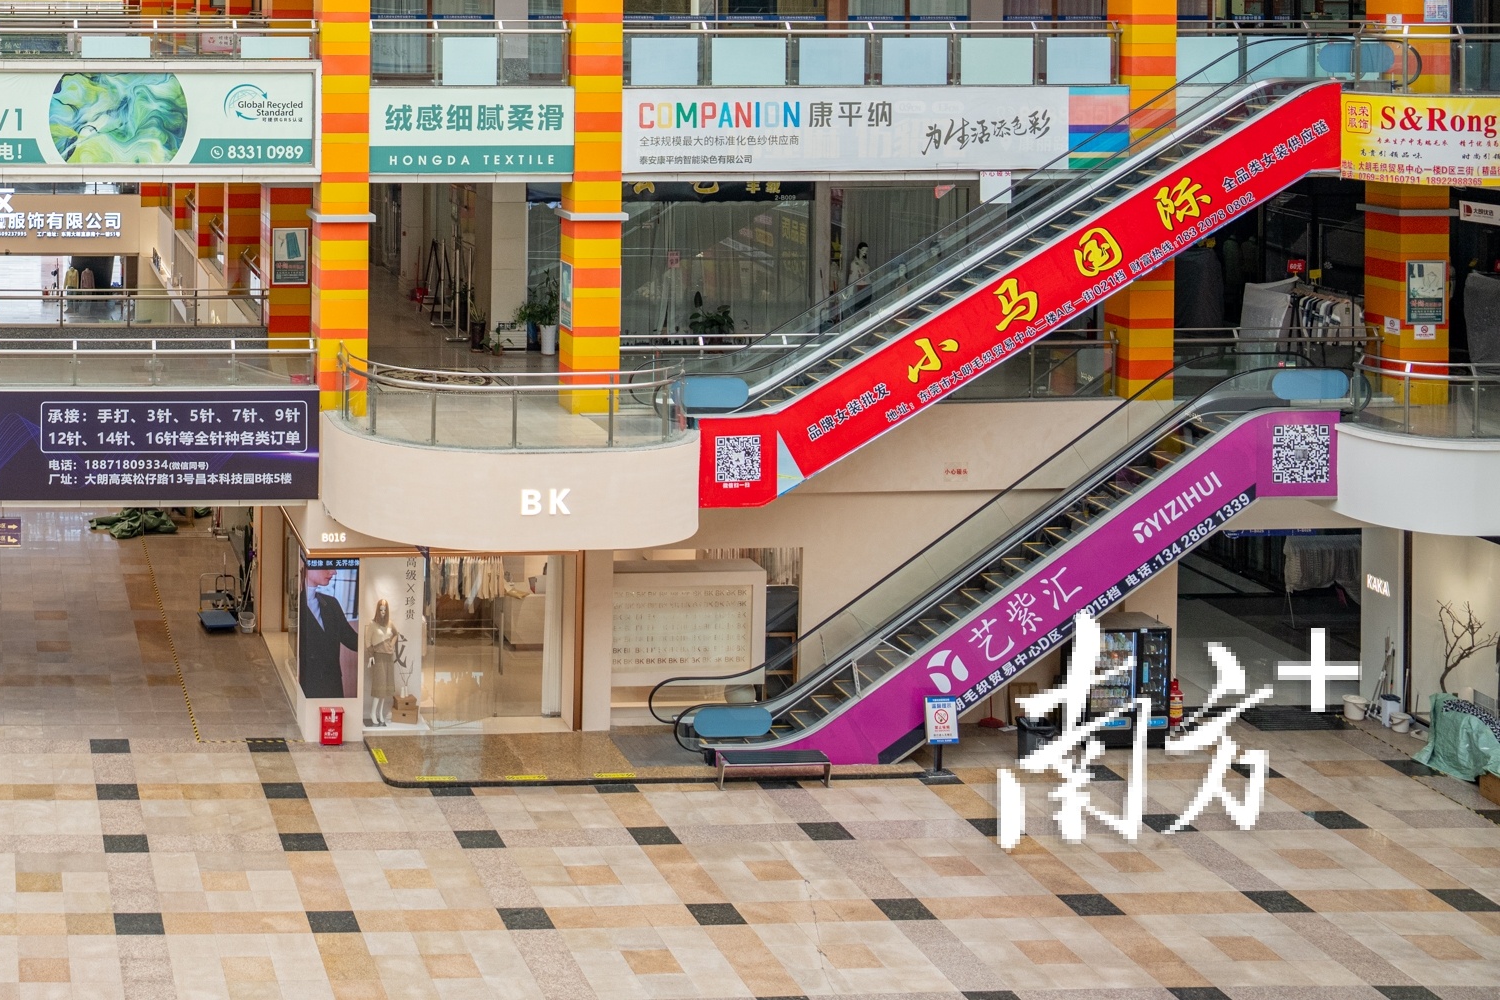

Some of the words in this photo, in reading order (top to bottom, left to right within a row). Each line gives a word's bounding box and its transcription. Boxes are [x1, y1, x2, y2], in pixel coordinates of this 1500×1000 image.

[237, 100, 265, 110] Global
[266, 100, 304, 110] Recycled
[256, 109, 294, 117] Standard
[385, 103, 565, 132] 绒感细腻柔滑
[638, 101, 800, 129] COMPANION
[807, 101, 892, 128] 康平纳
[1381, 105, 1498, 139] S&Rong
[227, 146, 262, 159] 8331
[266, 146, 304, 160] 0989
[639, 134, 800, 148] 全球规模最大的标准化色纱供应商
[389, 155, 470, 166] HONGDA
[483, 154, 555, 165] TEXTILE
[1221, 119, 1330, 193] 全品类女装供应链
[1198, 209, 1226, 233] 2078
[1226, 191, 1255, 215] 0802
[908, 176, 1212, 384] 小马国际
[806, 383, 891, 441] 品牌女装批发
[521, 488, 571, 516] BK
[1148, 471, 1222, 533] YIZIHUI
[1180, 517, 1217, 550] 2862
[1214, 492, 1251, 524] 1339
[321, 533, 346, 543] B016
[969, 566, 1082, 663] 艺紫汇
